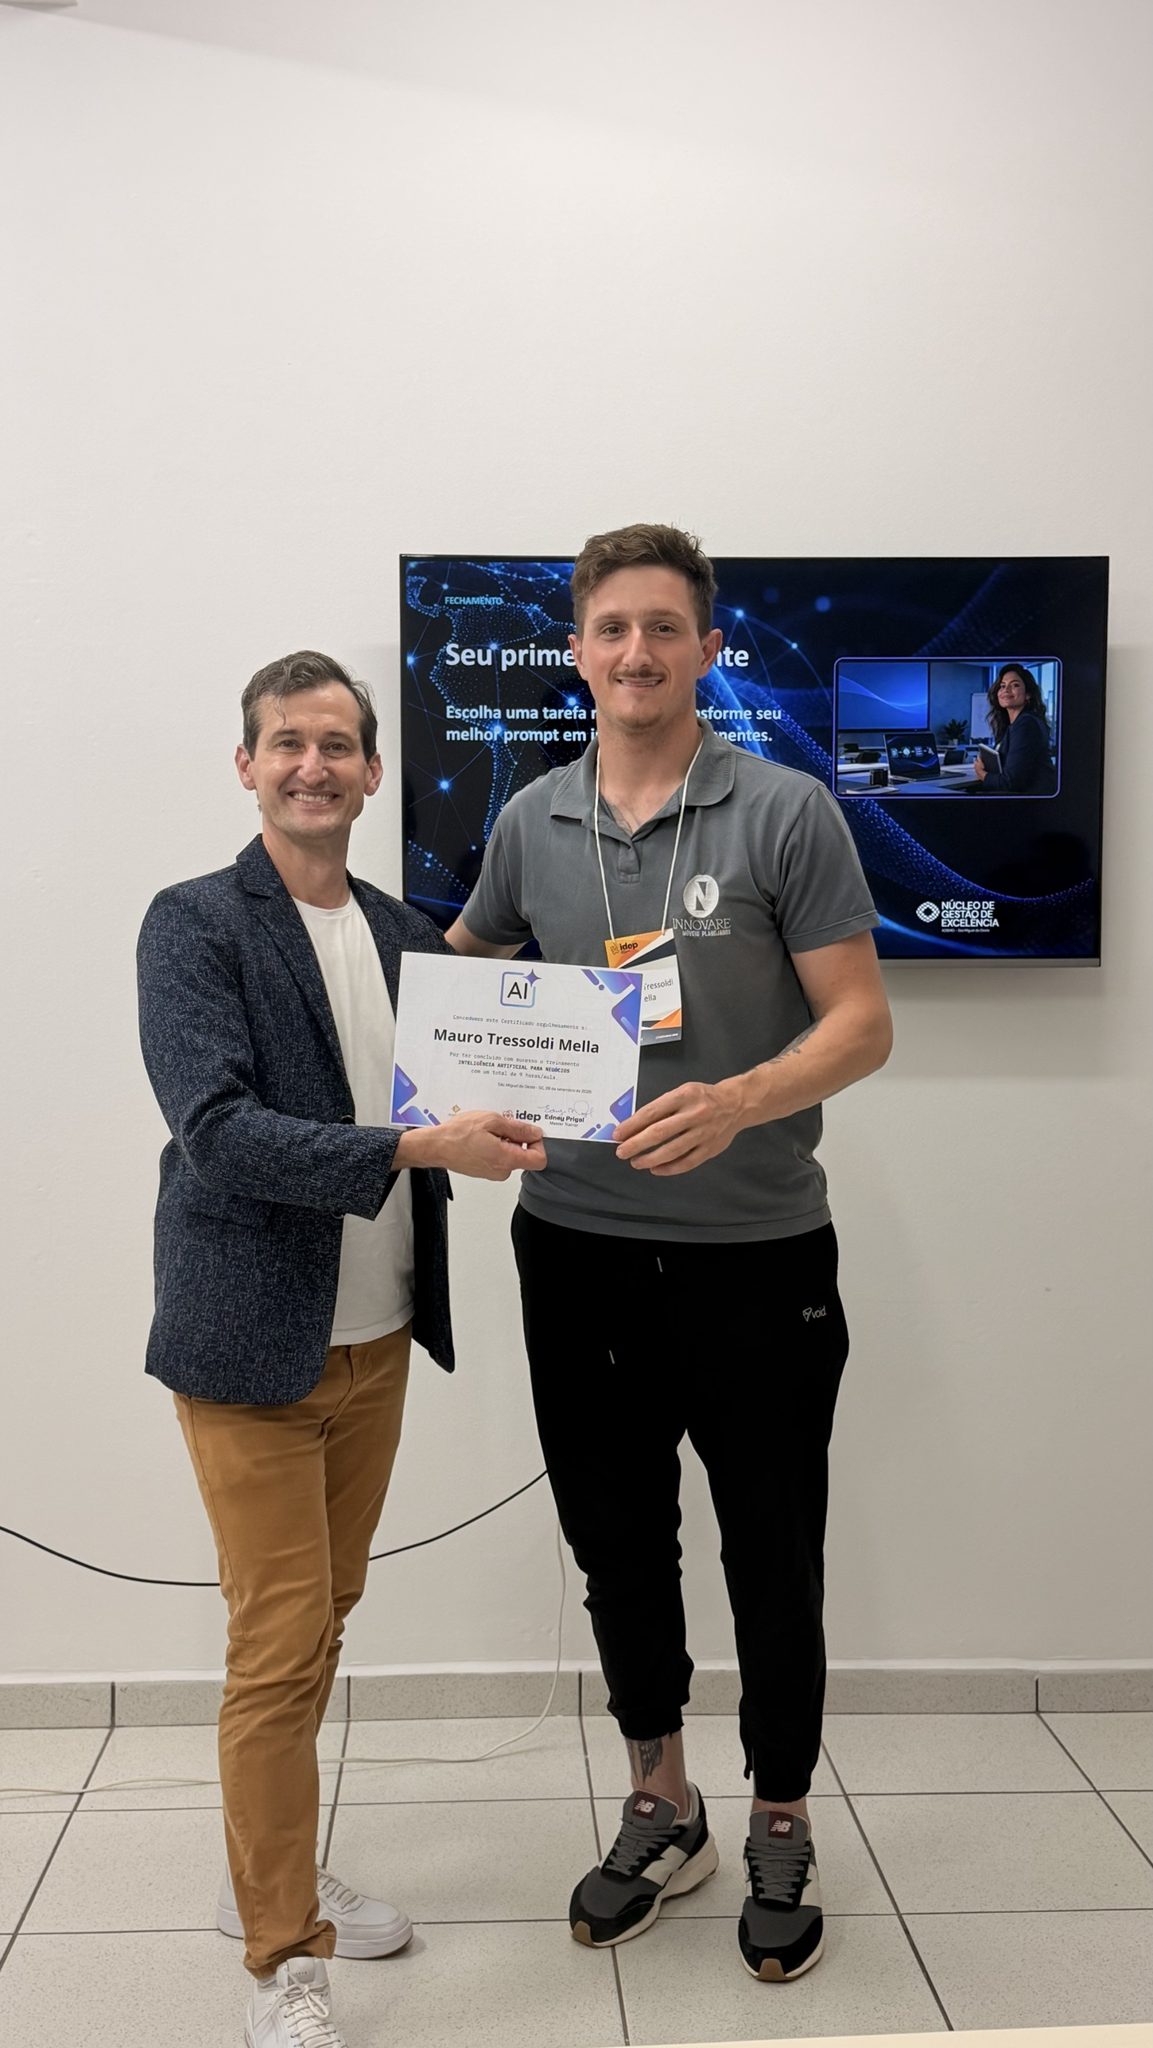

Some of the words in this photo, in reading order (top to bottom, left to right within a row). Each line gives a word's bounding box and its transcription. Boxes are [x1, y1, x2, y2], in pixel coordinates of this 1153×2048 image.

[445, 597, 502, 605] FECHAMENTO
[445, 643, 492, 666] Seu
[501, 643, 576, 671] prime
[446, 705, 501, 719] Escolha
[506, 709, 538, 719] uma
[543, 706, 586, 719] tarefa
[756, 710, 782, 720] seu
[446, 727, 499, 741] melhor
[504, 728, 559, 744] prompt
[563, 731, 587, 741] em
[714, 731, 773, 742] nentes.
[941, 899, 981, 910] NÚCLEO
[982, 901, 995, 910] DE
[941, 908, 979, 919] GESTÃO
[981, 910, 994, 919] DE
[673, 918, 732, 930] INNOVARE
[507, 981, 528, 1000] AI
[643, 994, 657, 1002] ella
[501, 1017, 534, 1026] Certificado
[434, 1028, 483, 1044] Mauro
[487, 1032, 554, 1050] Tressoldi
[559, 1038, 599, 1054] Mella
[458, 1059, 495, 1067] INTELIGÊNCIA
[546, 1059, 580, 1067] treinamento
[516, 1110, 541, 1122] idep
[545, 1114, 564, 1122] Edney
